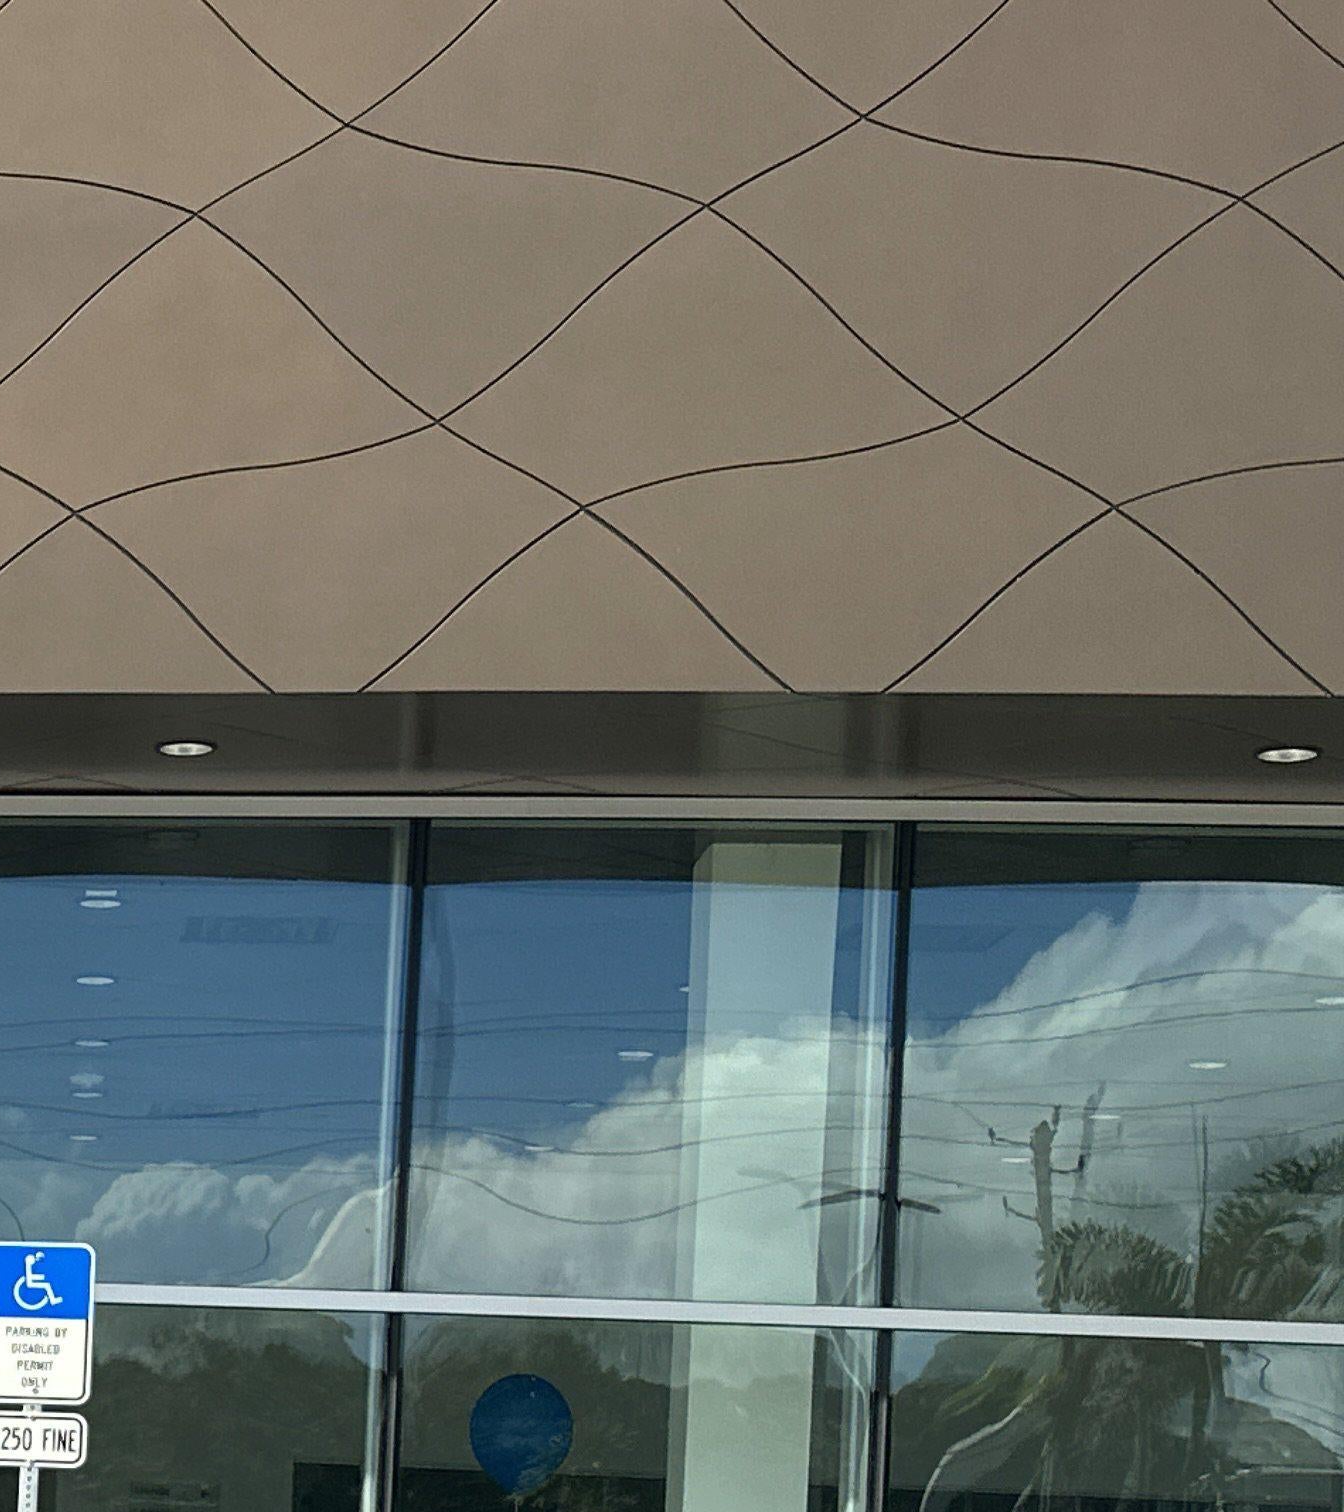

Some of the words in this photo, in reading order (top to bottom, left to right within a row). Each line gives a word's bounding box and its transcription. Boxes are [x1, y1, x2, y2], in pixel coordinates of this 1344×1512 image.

[5, 1326, 49, 1337] PARKING
[55, 1328, 68, 1338] BY
[12, 1343, 60, 1355] DISABLED
[17, 1360, 53, 1371] PERMIT
[21, 1377, 48, 1388] ONLY
[42, 1429, 77, 1453] FINE
